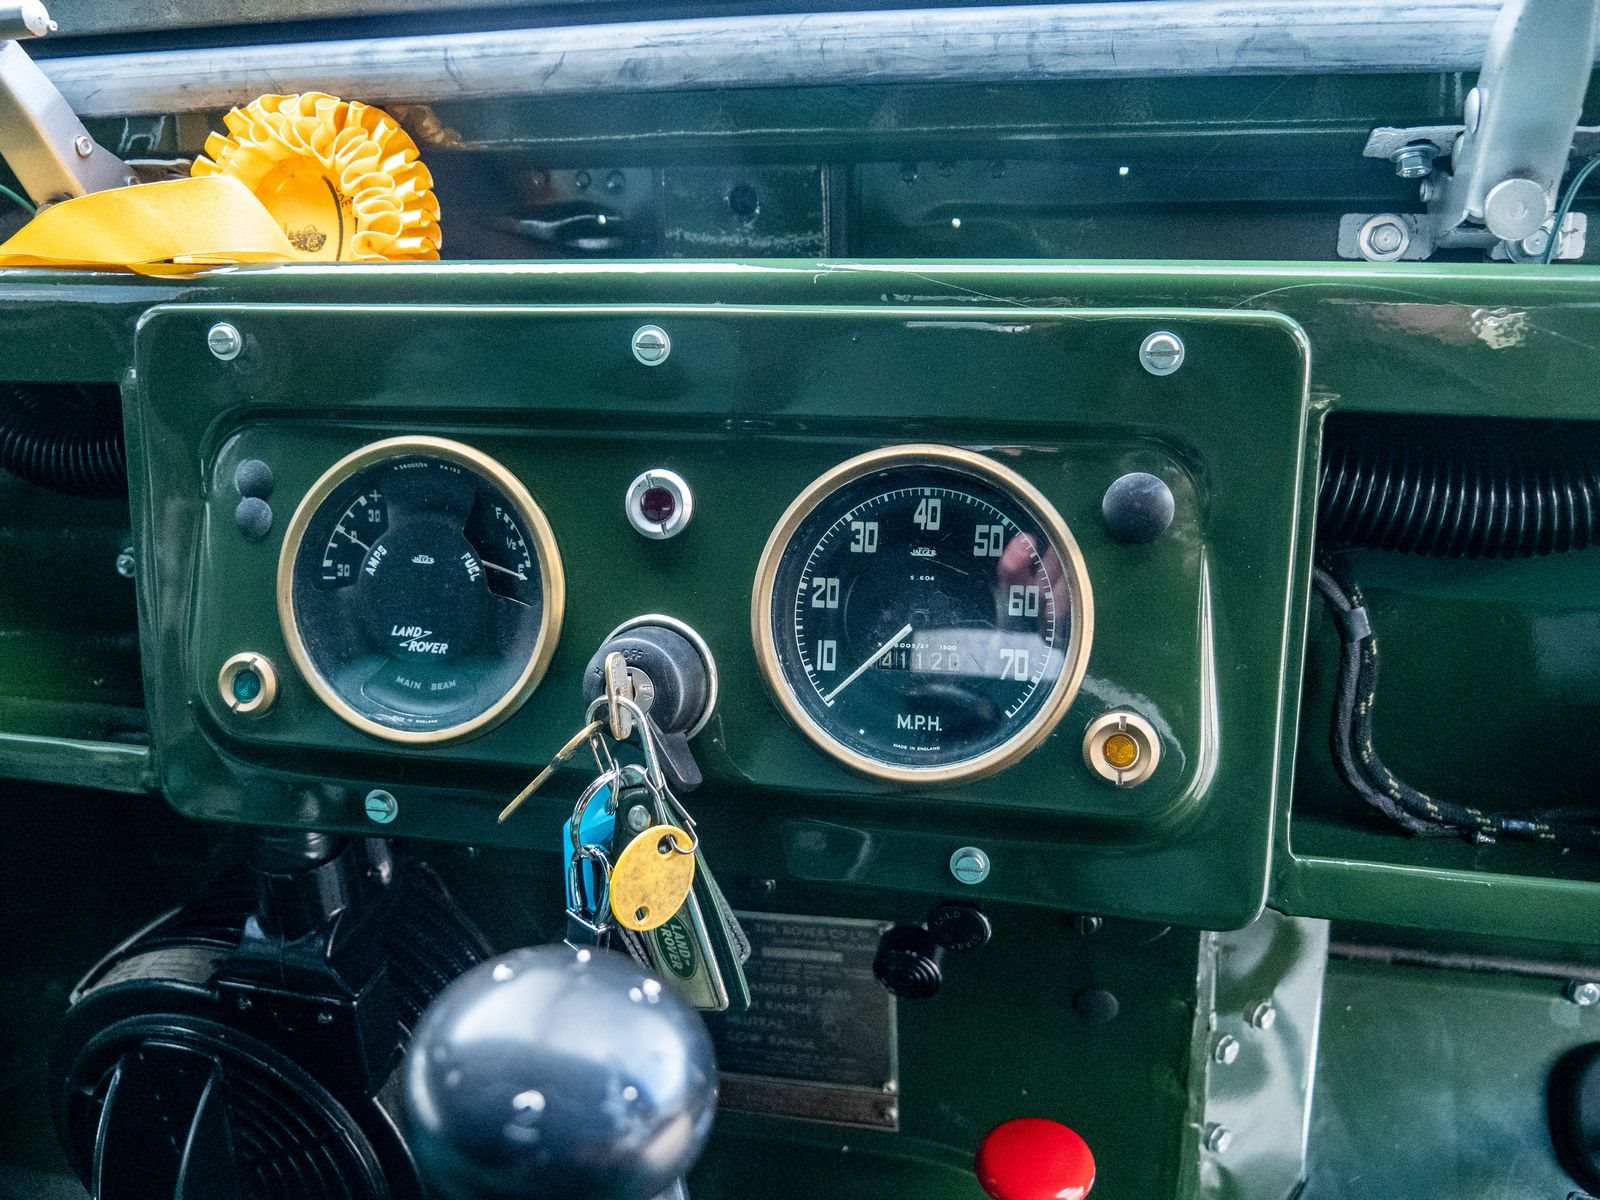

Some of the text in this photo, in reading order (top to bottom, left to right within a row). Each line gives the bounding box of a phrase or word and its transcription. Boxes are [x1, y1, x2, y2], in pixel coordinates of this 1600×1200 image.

[368, 509, 381, 522] 30
[495, 506, 502, 519] F
[913, 498, 941, 531] 40
[850, 521, 879, 553] 30
[973, 524, 1004, 557] 50
[337, 564, 350, 577] 30
[365, 545, 388, 576] AMPS
[461, 552, 480, 582] FUEL
[811, 577, 840, 609] 20
[1008, 585, 1040, 617] 60
[391, 625, 422, 637] LAND
[408, 640, 449, 654] ROVER
[622, 648, 644, 660] OFF
[816, 639, 837, 671] 10
[1000, 648, 1029, 681] 70
[395, 675, 457, 691] MAIN BEAM
[897, 713, 942, 731] M.P.H.
[661, 928, 684, 970] ROVER
[670, 923, 691, 961] LAND
